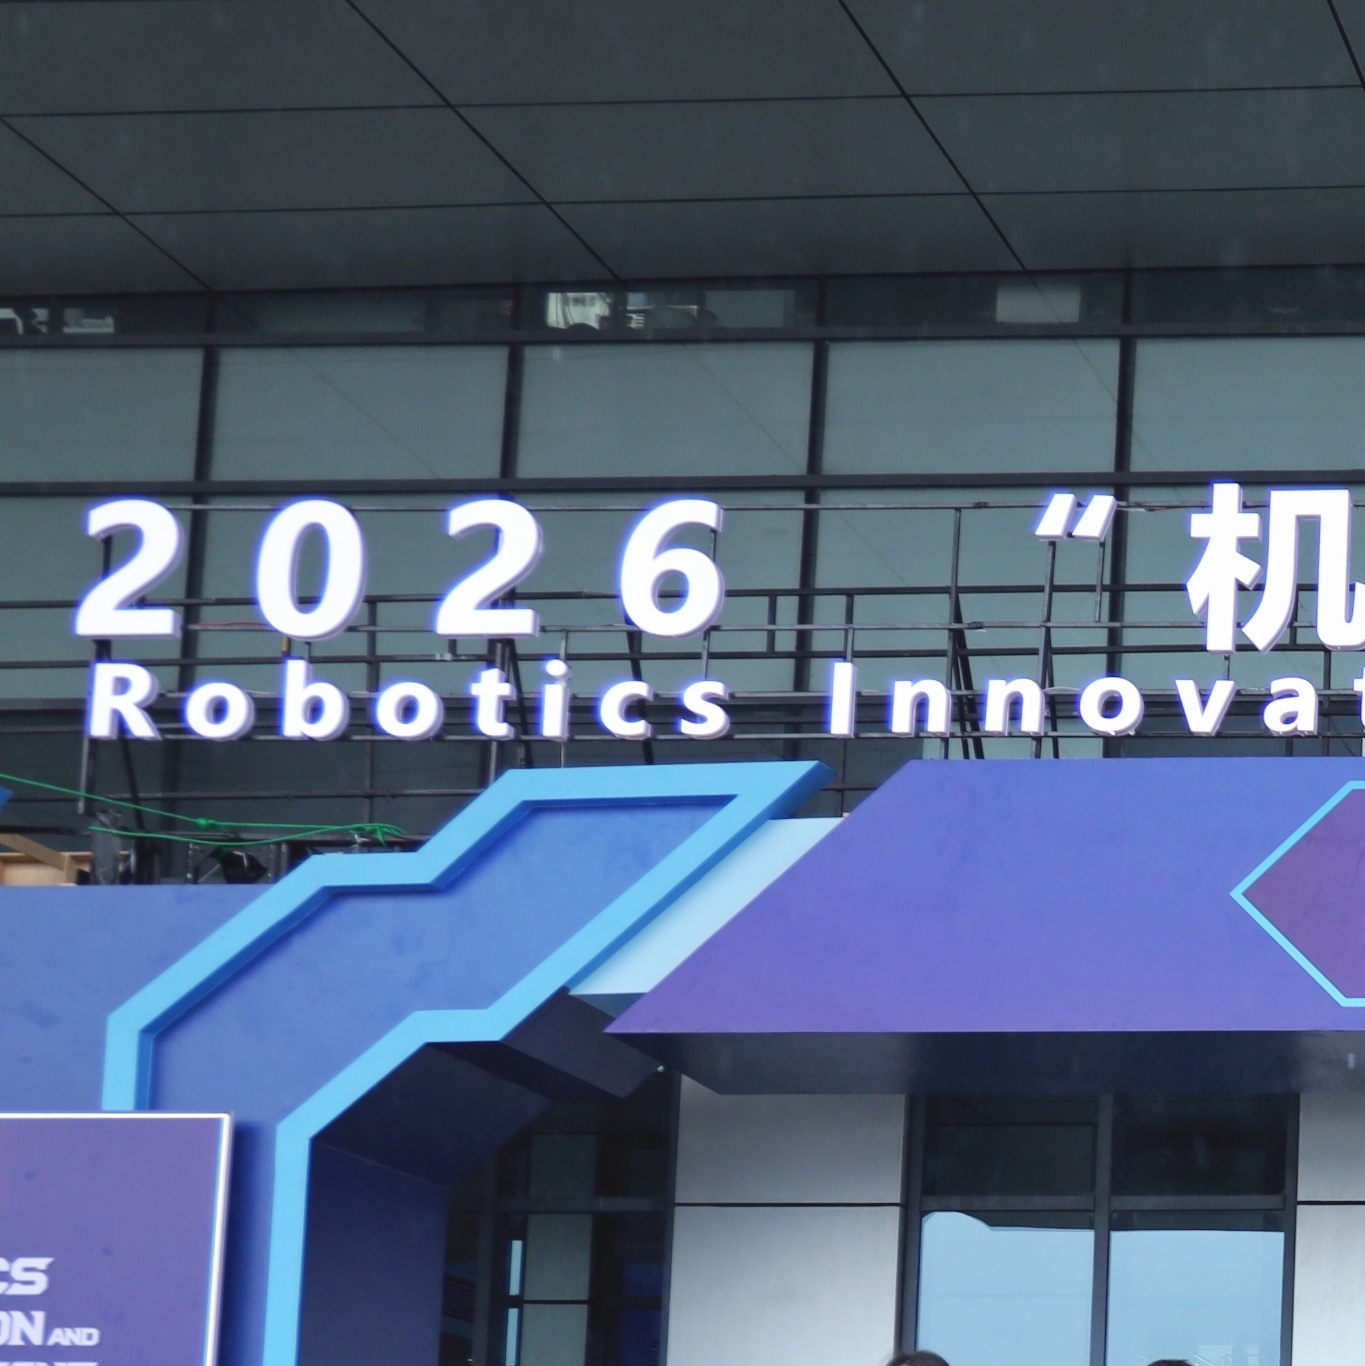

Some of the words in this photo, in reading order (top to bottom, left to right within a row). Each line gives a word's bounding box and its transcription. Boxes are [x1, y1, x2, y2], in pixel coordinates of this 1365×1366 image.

[75, 498, 724, 640] 2026
[90, 658, 732, 741] Robotics
[46, 1327, 101, 1347] AND
